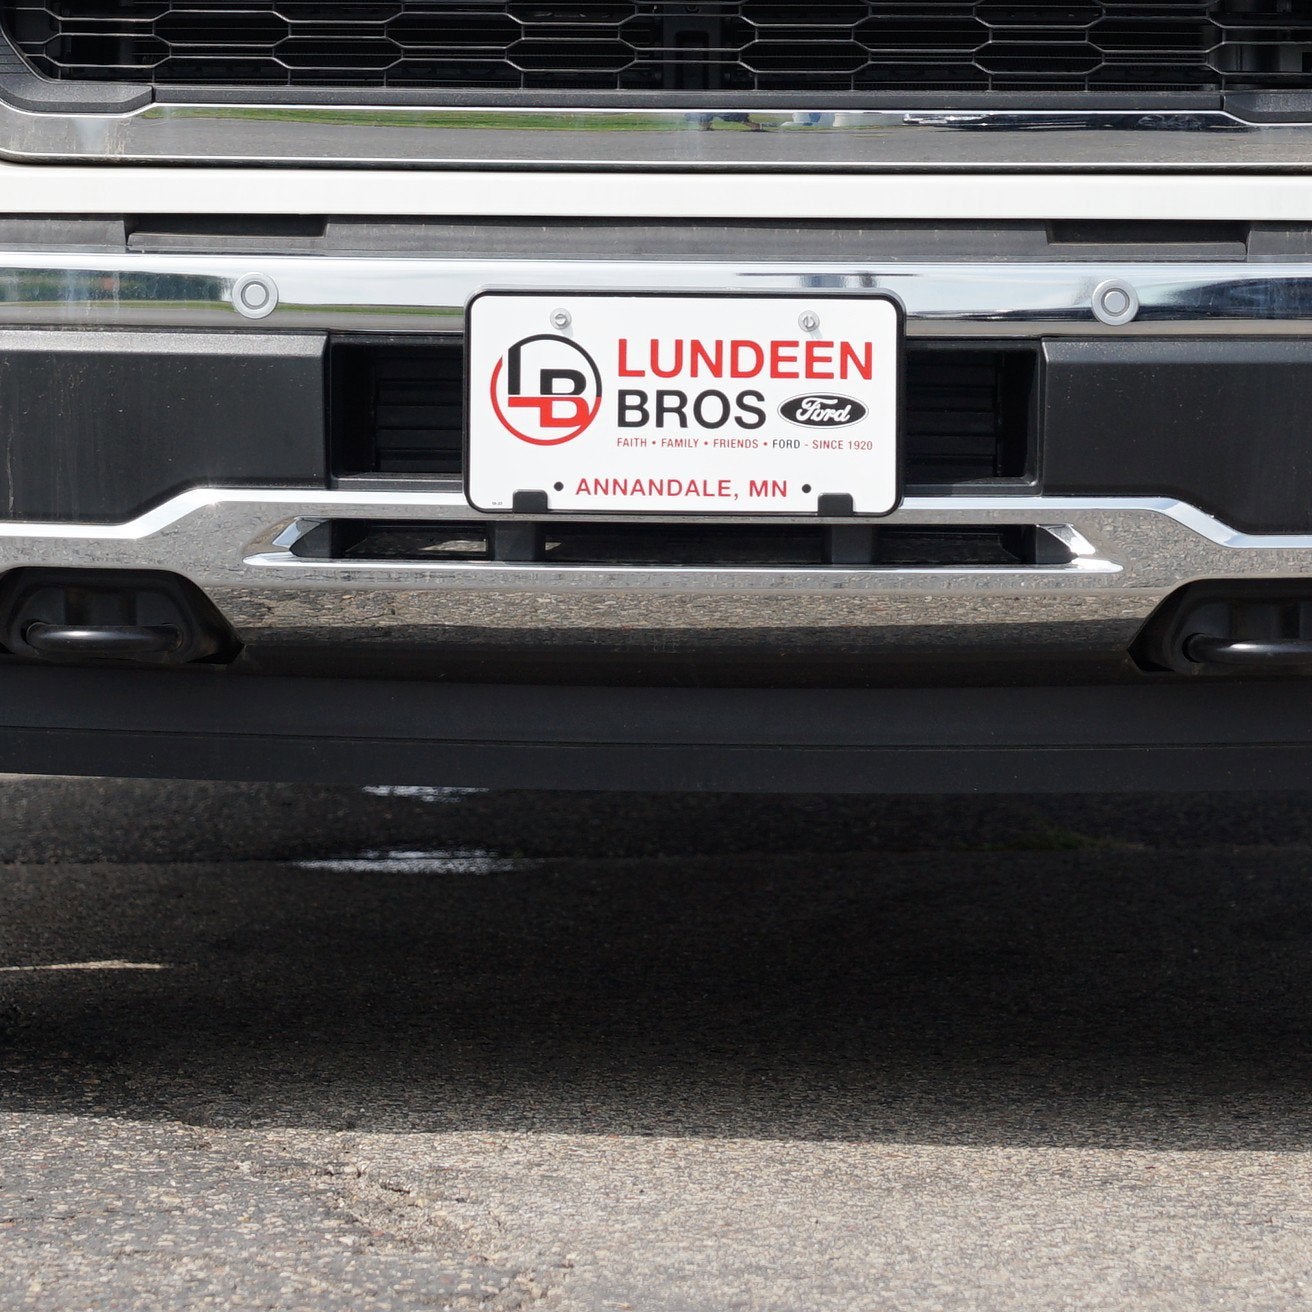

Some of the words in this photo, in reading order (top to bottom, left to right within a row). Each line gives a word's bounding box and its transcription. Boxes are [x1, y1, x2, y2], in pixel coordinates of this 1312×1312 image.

[618, 339, 873, 380] LUNDEEN
[618, 390, 767, 429] BROS
[796, 397, 852, 422] Ford
[617, 437, 647, 448] FAITH
[661, 438, 699, 448] FAMILY
[713, 438, 759, 449] FRIENDS
[772, 438, 801, 449] FORD
[812, 439, 844, 450] SINCE
[848, 440, 873, 451] 1920
[576, 478, 739, 500] ANNANDALE,
[750, 479, 787, 497] MN
